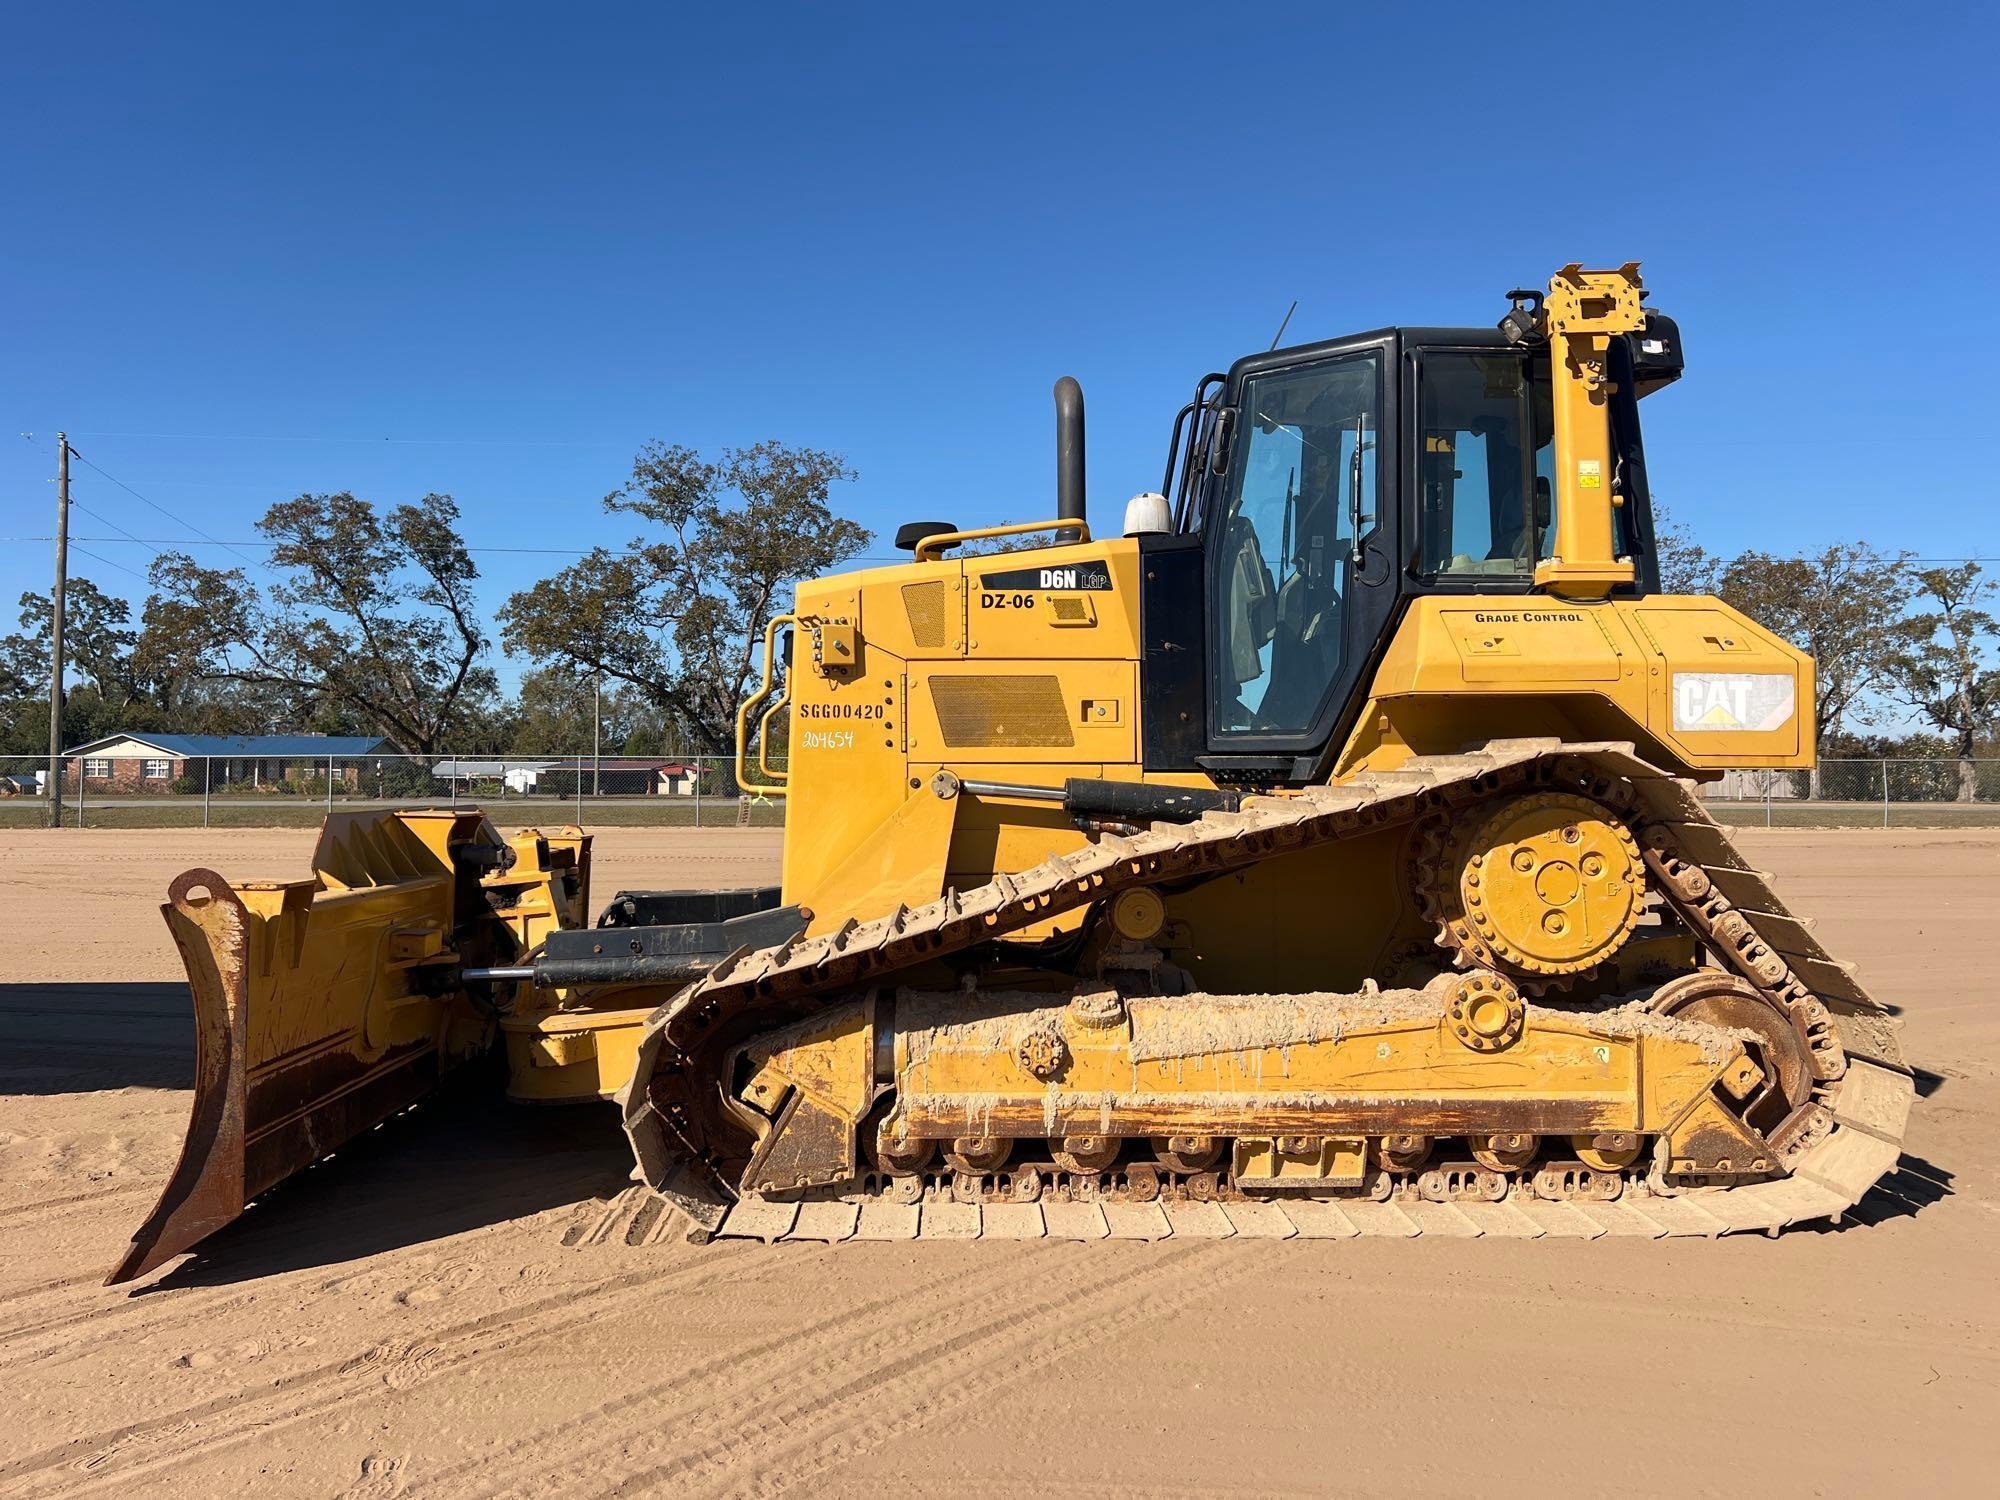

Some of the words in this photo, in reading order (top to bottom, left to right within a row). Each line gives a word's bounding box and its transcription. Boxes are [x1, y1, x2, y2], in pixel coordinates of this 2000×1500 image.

[1040, 569, 1076, 589] D6N
[1081, 574, 1107, 589] LGP
[981, 593, 1035, 609] DZ-06
[1475, 613, 1519, 623] GRADE
[1523, 613, 1584, 622] CONTROL
[1679, 679, 1753, 725] CAT
[800, 703, 884, 719] SGG00420
[802, 731, 854, 749] 204654
